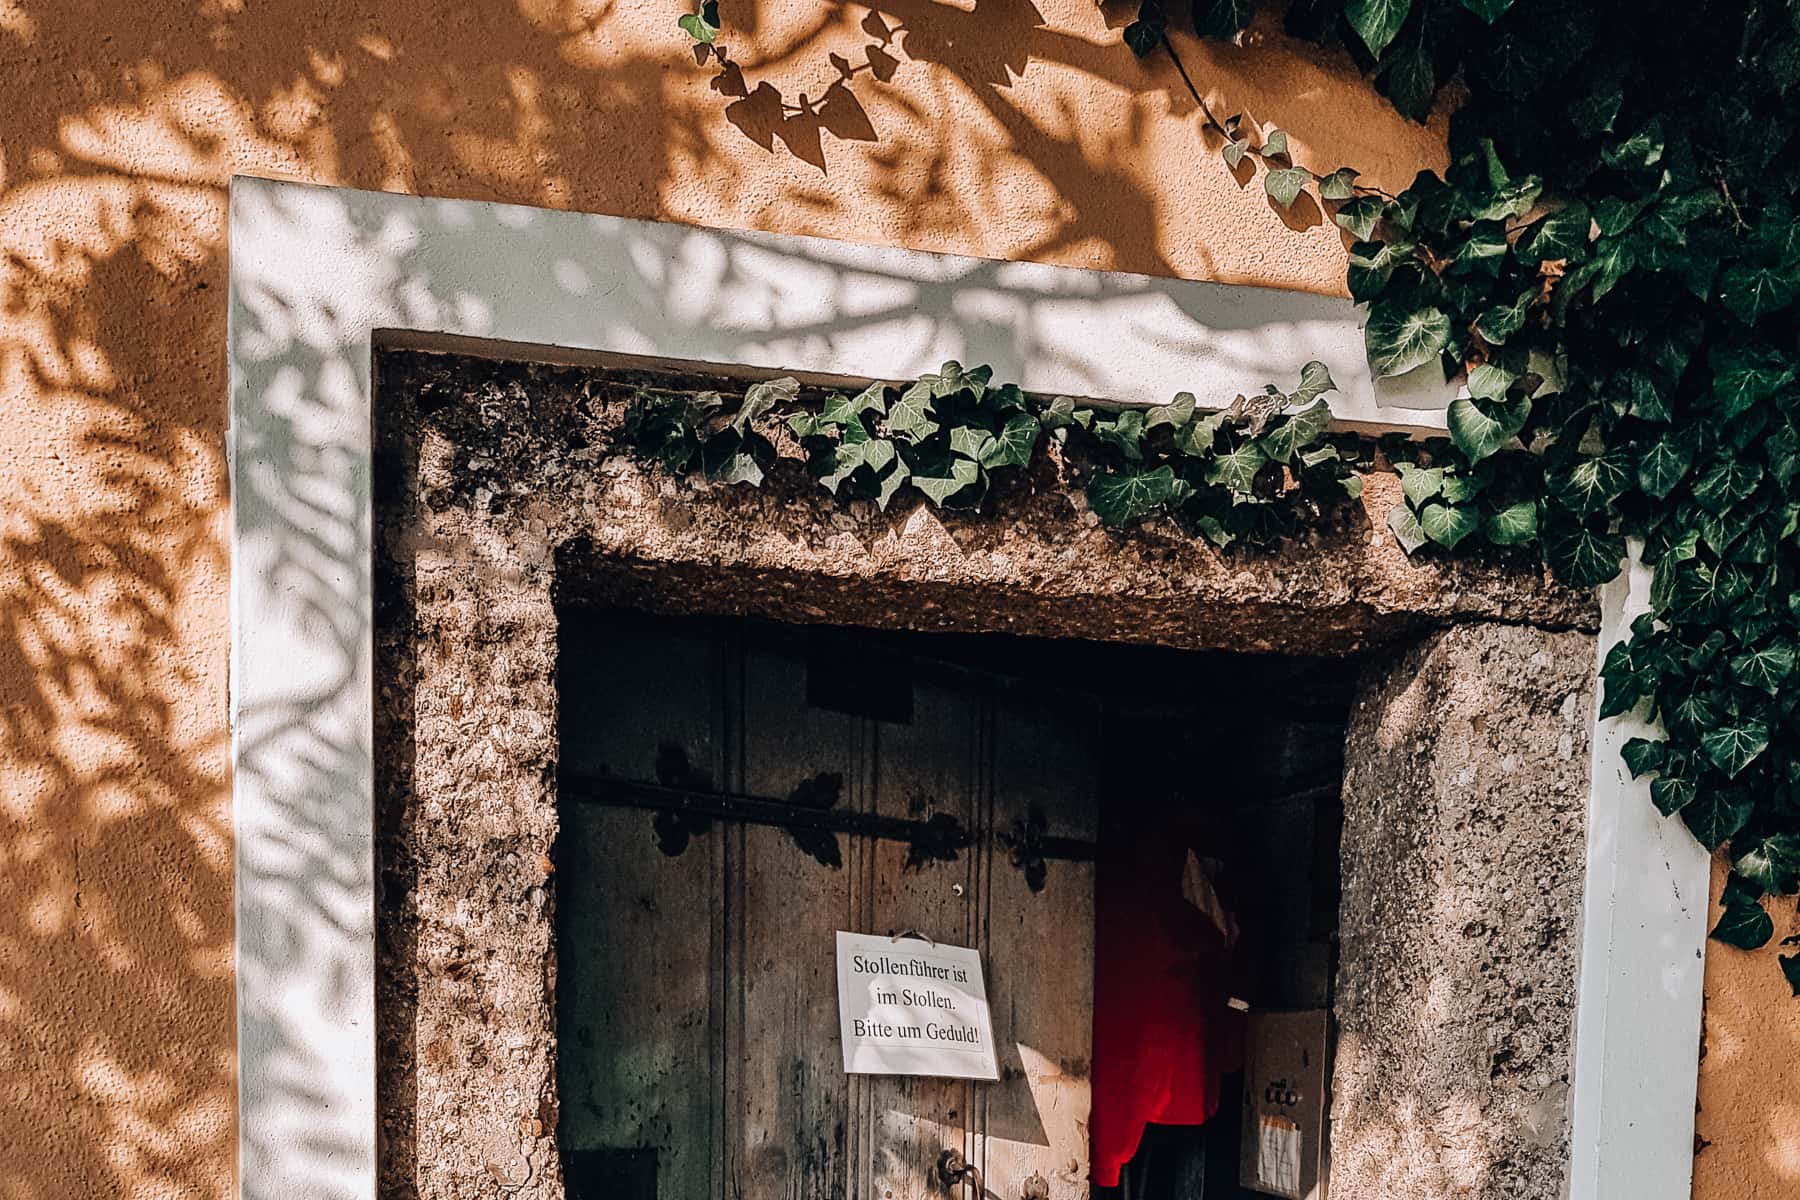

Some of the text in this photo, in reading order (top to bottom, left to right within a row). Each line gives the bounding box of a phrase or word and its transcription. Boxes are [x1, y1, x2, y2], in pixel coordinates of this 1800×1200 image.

[853, 955, 969, 983] Stollenführer ist
[876, 987, 956, 1010] im Stollen.
[853, 1019, 980, 1044] Bitte um Geduld!
